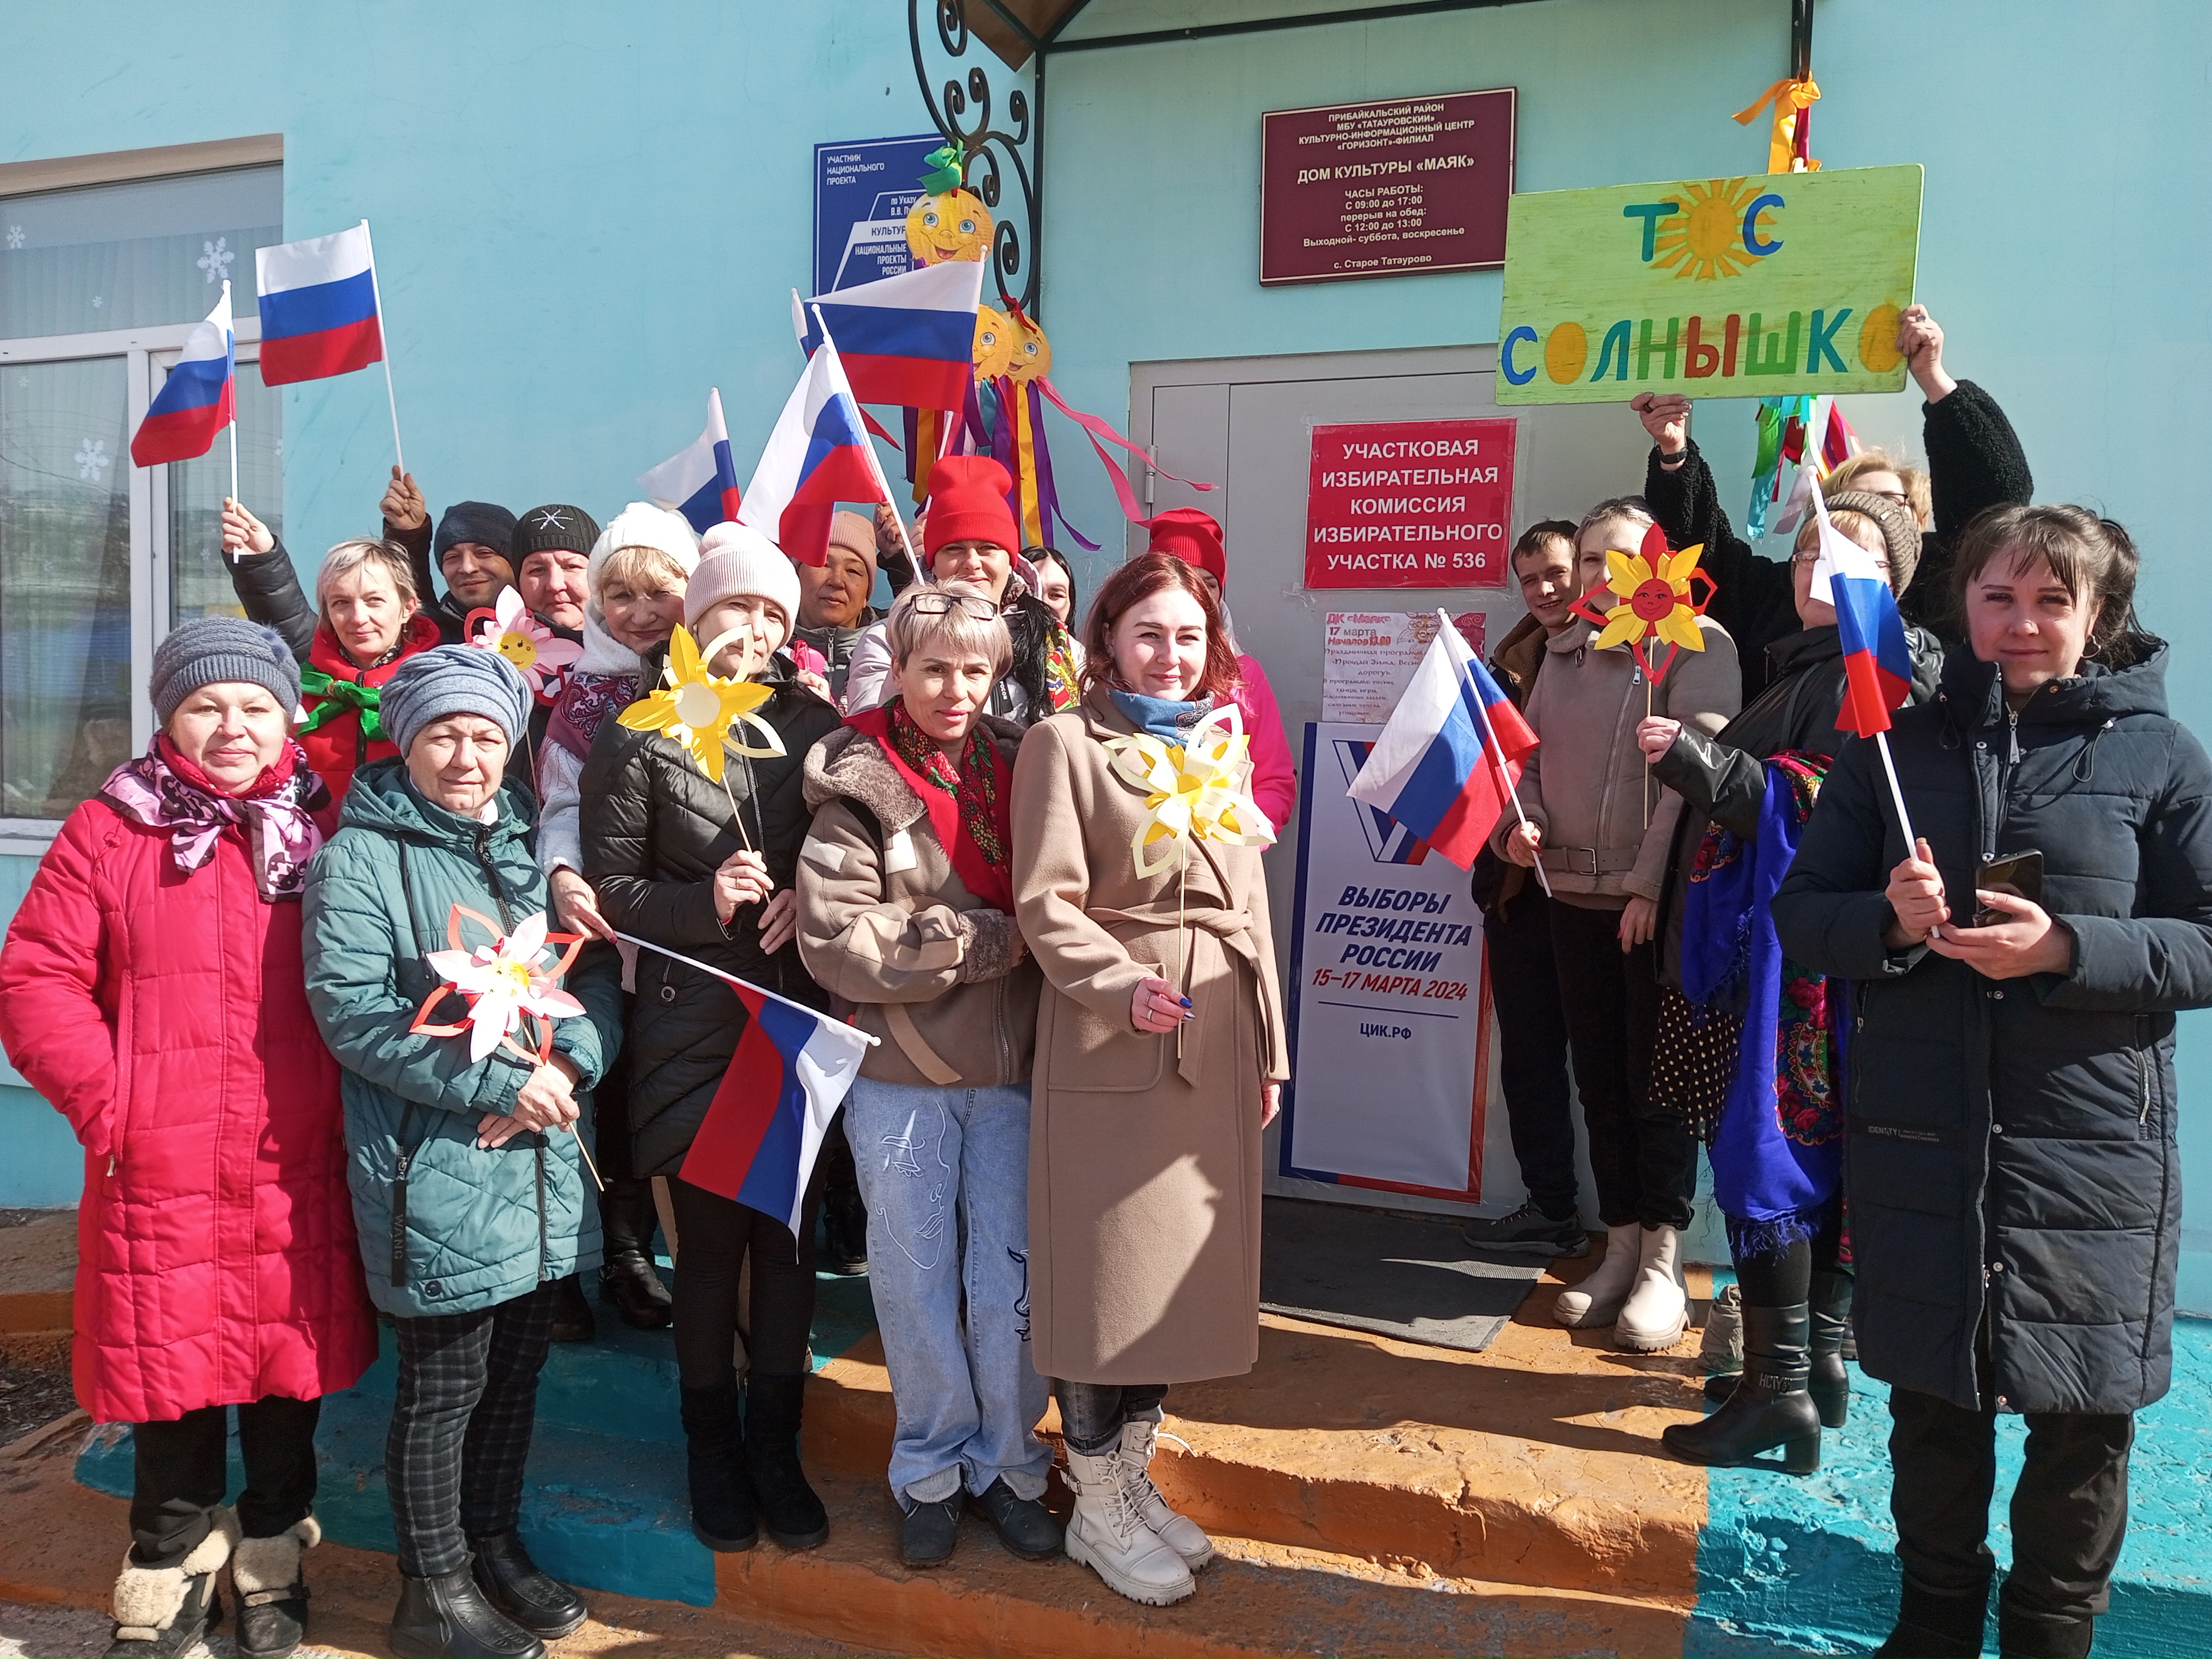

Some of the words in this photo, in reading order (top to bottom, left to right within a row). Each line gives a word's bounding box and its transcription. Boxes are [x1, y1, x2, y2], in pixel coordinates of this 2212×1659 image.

[1329, 106, 1411, 122] ПРИБАЙКАЛЬСКИЙ
[1414, 103, 1444, 114] РАЙОН
[1299, 122, 1442, 144] КУЛЬТУРНО-ИНФОРМАЦИОННЫЙ
[1445, 120, 1474, 131] ЦЕНТР
[1337, 122, 1355, 131] МБУ
[1337, 134, 1434, 150] «ГОРИЗОНТ»-ФИЛИАЛ
[827, 154, 861, 164] УЧАСТНИК
[827, 163, 884, 175] НАЦИОНАЛЬНОГО
[1298, 169, 1330, 184] ДОМ
[1335, 160, 1411, 179] КУЛЬТУРЫ
[1416, 155, 1474, 171] «МАЯК»
[827, 176, 856, 185] ПРОЕКТА
[1345, 188, 1374, 199] ЧАСЫ
[1378, 185, 1423, 196] РАБОТЫ:
[1345, 202, 1352, 210] С
[1355, 199, 1379, 209] 09:00
[1382, 199, 1394, 208] до
[1397, 195, 1422, 206] 17:00
[891, 207, 902, 216] В.В.
[1341, 212, 1383, 222] перерыв
[1399, 207, 1426, 218] обед:
[871, 225, 906, 236] КУЛЬТУР
[1345, 224, 1351, 232] С
[1355, 222, 1379, 231] 12:00
[1381, 222, 1394, 230] до
[1397, 218, 1422, 228] 13:00
[1304, 236, 1356, 247] Выходной-
[1359, 232, 1400, 243] суббота,
[1403, 226, 1465, 239] воскресенье
[855, 243, 907, 255] НАЦИОНАЛЬНЫЕ
[877, 255, 907, 264] ПРОЕКТЫ
[1344, 259, 1378, 268] Старое
[1381, 255, 1431, 266] Татаурово
[882, 265, 907, 275] РОССИИ
[1501, 303, 1903, 385] СОЛНЫШКО
[1343, 439, 1478, 459] УЧАСТКОВАЯ
[1322, 467, 1498, 488] ИЗБИРАТЕЛЬНАЯ
[1350, 496, 1465, 514] КОМИССИЯ
[1314, 524, 1503, 543] ИЗБИРАТЕЛЬНОГО
[1328, 554, 1418, 570] УЧАСТКА
[1425, 553, 1446, 568] №
[1452, 552, 1486, 568] 536
[1327, 613, 1345, 625] ДК
[1330, 626, 1341, 636] 17
[1343, 629, 1377, 638] марта
[1338, 885, 1451, 914] ВЫБОРЫ
[1316, 913, 1472, 946] ПРЕЗИДЕНТА
[1340, 944, 1442, 973] РОССИИ
[1361, 973, 1421, 996] МАРТА
[1423, 980, 1468, 1001] 2024
[1360, 1023, 1412, 1040] ЦИК.РФ
